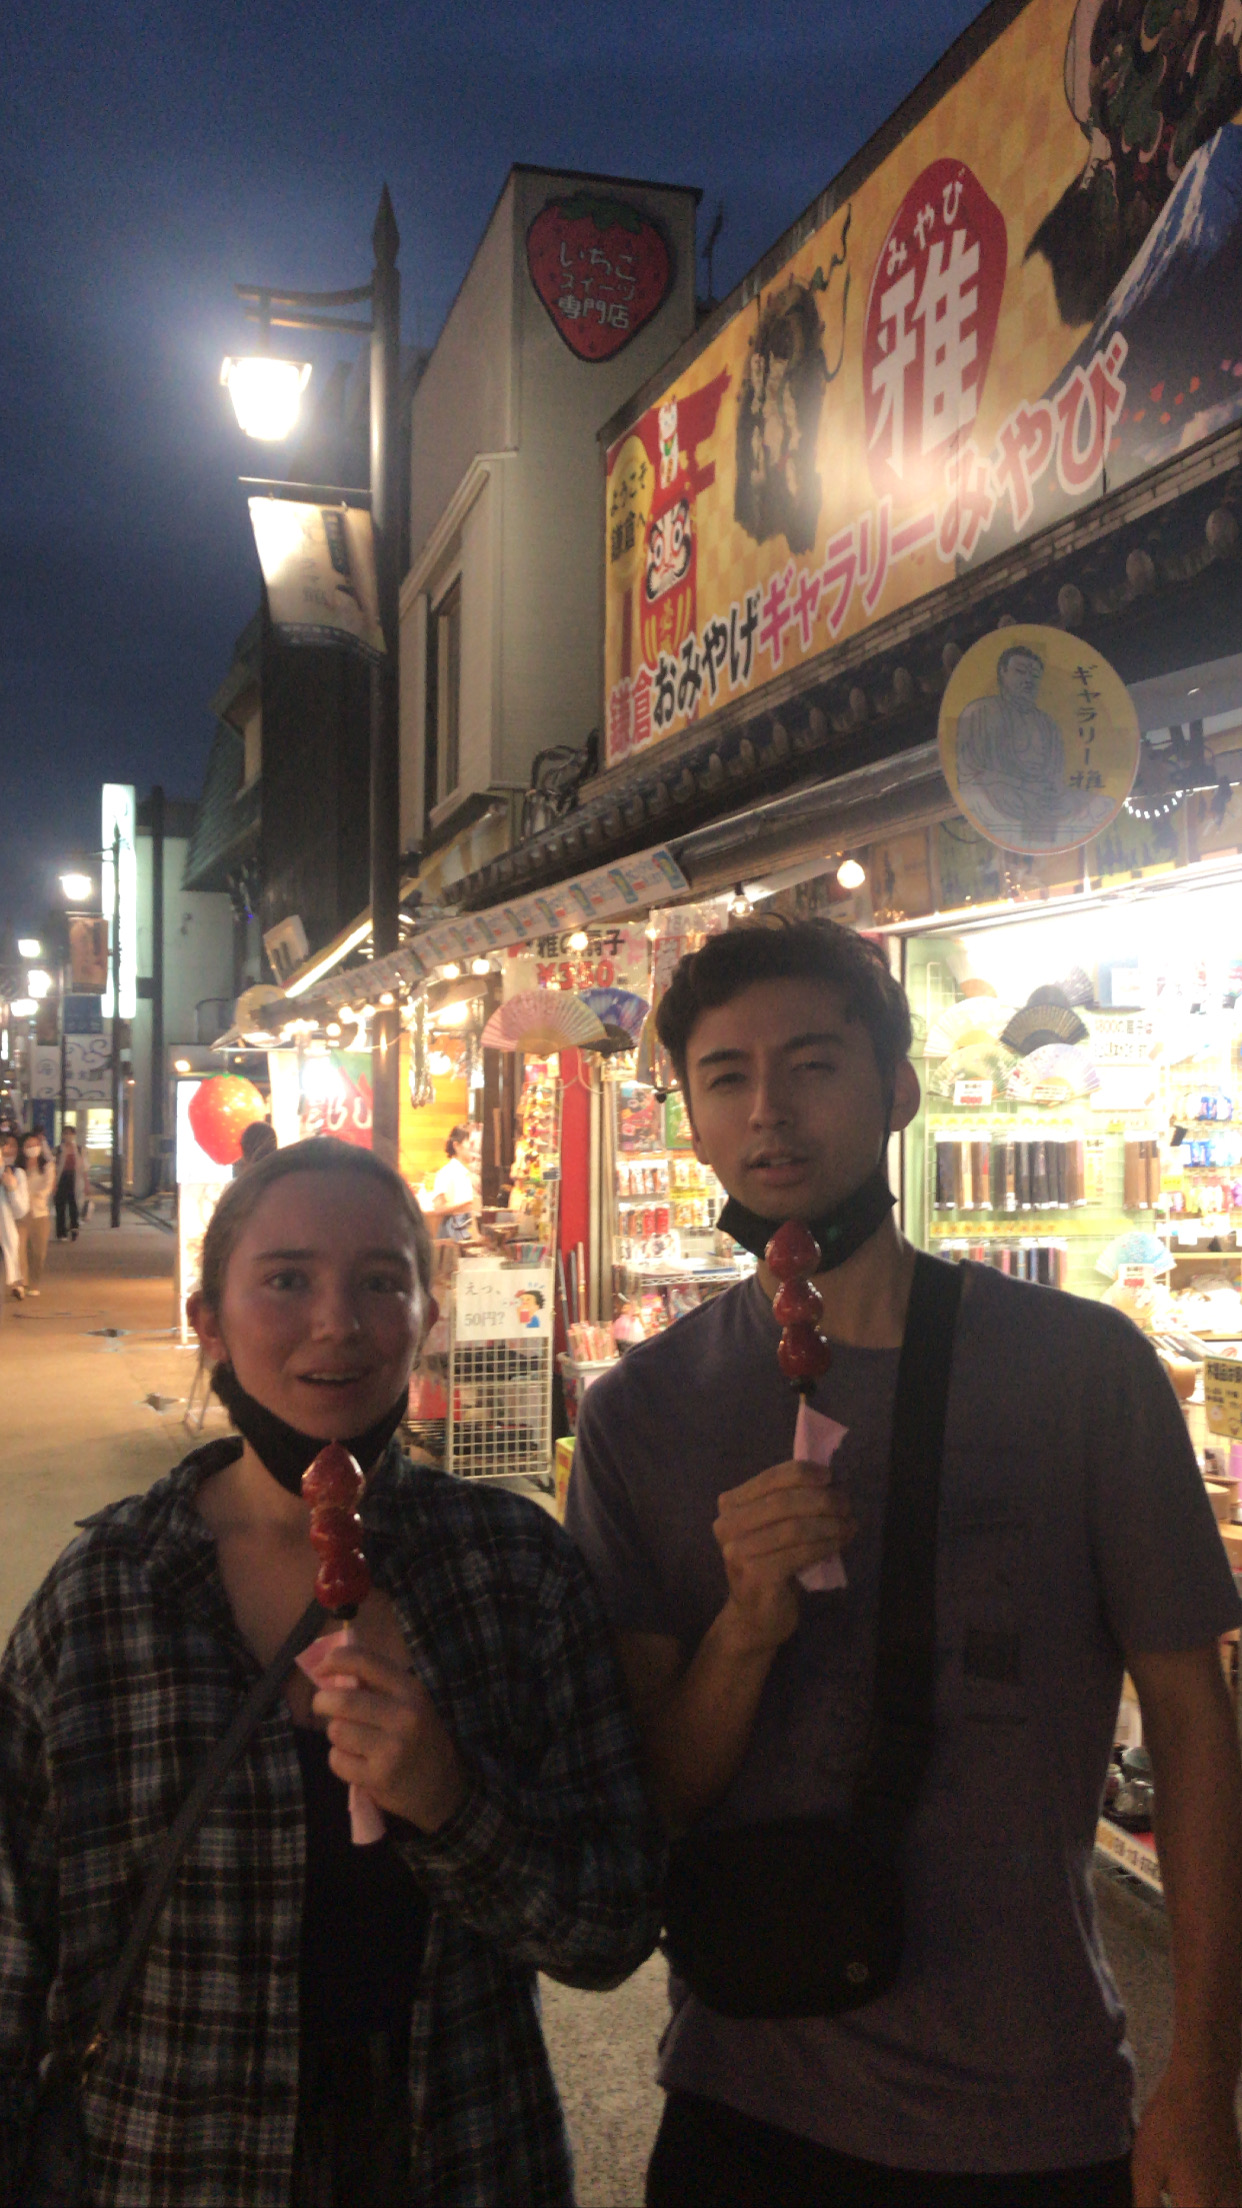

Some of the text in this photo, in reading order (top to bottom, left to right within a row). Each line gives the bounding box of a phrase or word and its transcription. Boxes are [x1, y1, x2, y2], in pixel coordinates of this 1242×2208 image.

[886, 167, 966, 275] みやび
[868, 228, 980, 479] 雅
